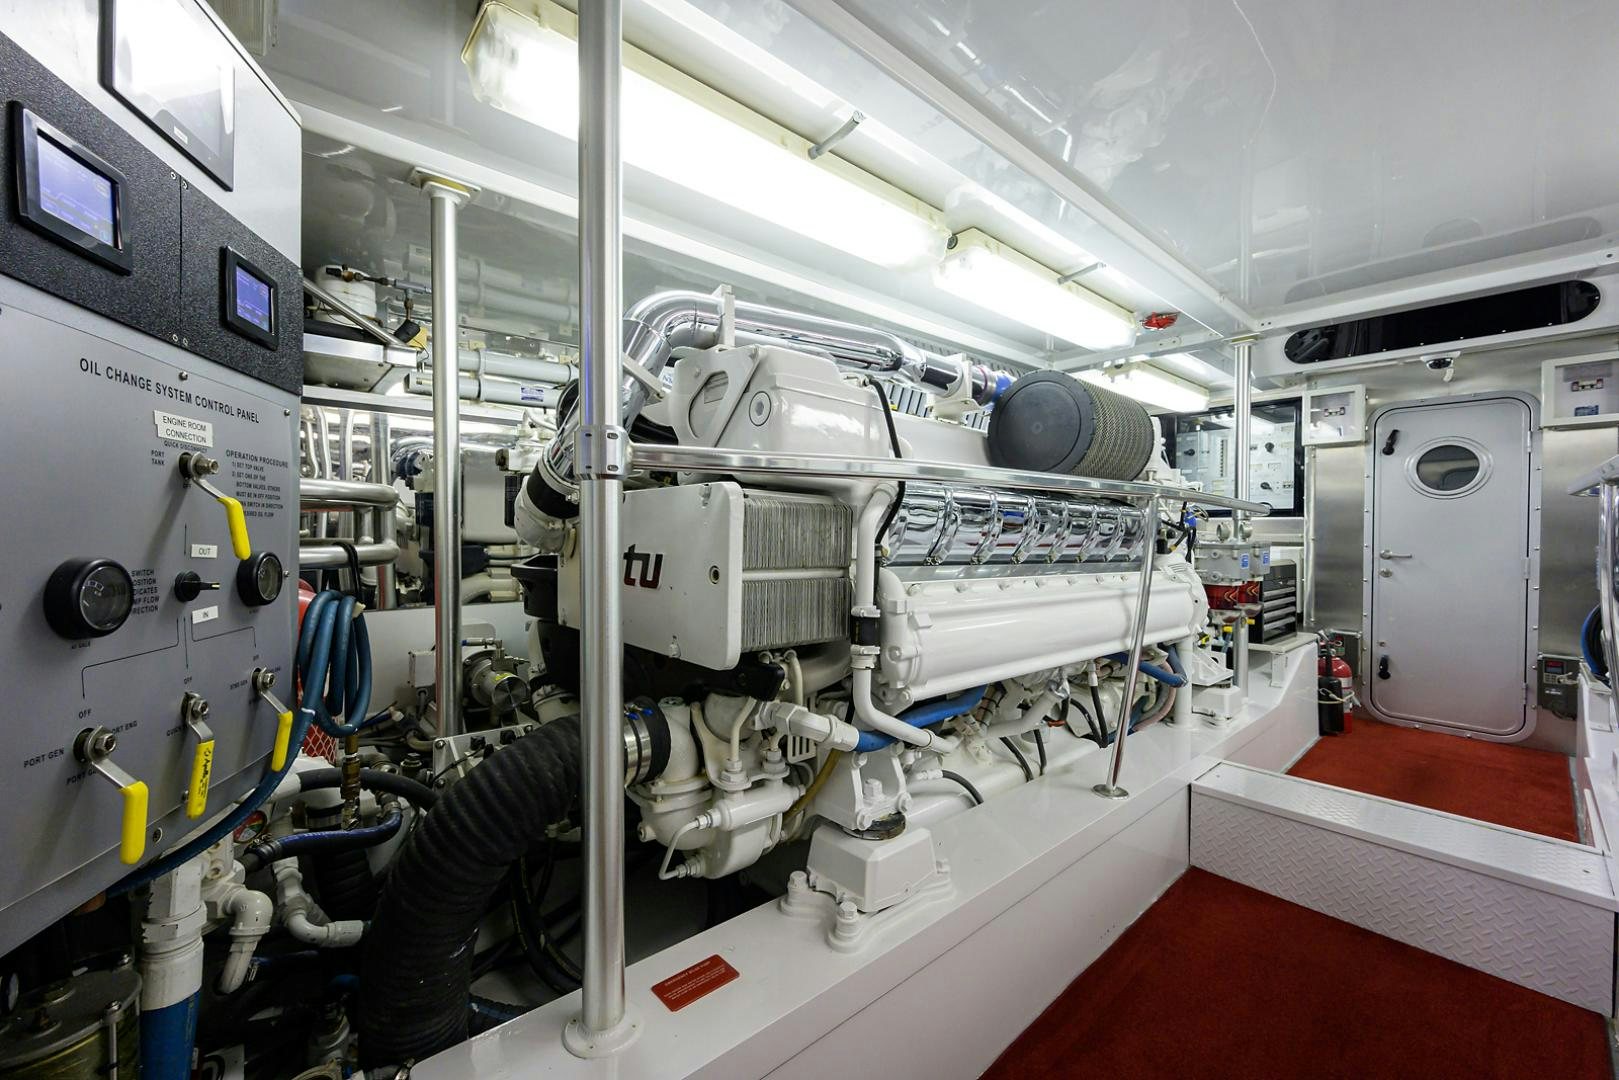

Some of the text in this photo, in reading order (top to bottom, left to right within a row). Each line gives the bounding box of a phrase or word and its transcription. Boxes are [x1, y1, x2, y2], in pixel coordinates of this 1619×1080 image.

[80, 358, 259, 423] OIL CHANGE SYSTEM CONTROL PANEL
[162, 416, 207, 432] ENGINE ROOM
[166, 428, 207, 443] CONNECTION
[164, 440, 179, 449] QUICK
[151, 450, 165, 458] PORT
[225, 449, 289, 468] OPERATION PROCEDURE
[152, 458, 165, 466] TANK
[199, 548, 211, 556] OUT
[623, 544, 663, 589] tu
[131, 569, 154, 577] SWITCH
[133, 578, 156, 586] OSITION
[143, 596, 160, 604] FLOW
[78, 708, 92, 719] OFF
[111, 720, 138, 735] ORT ENG
[23, 748, 65, 768] PORT GEN
[66, 772, 86, 786] PORT
